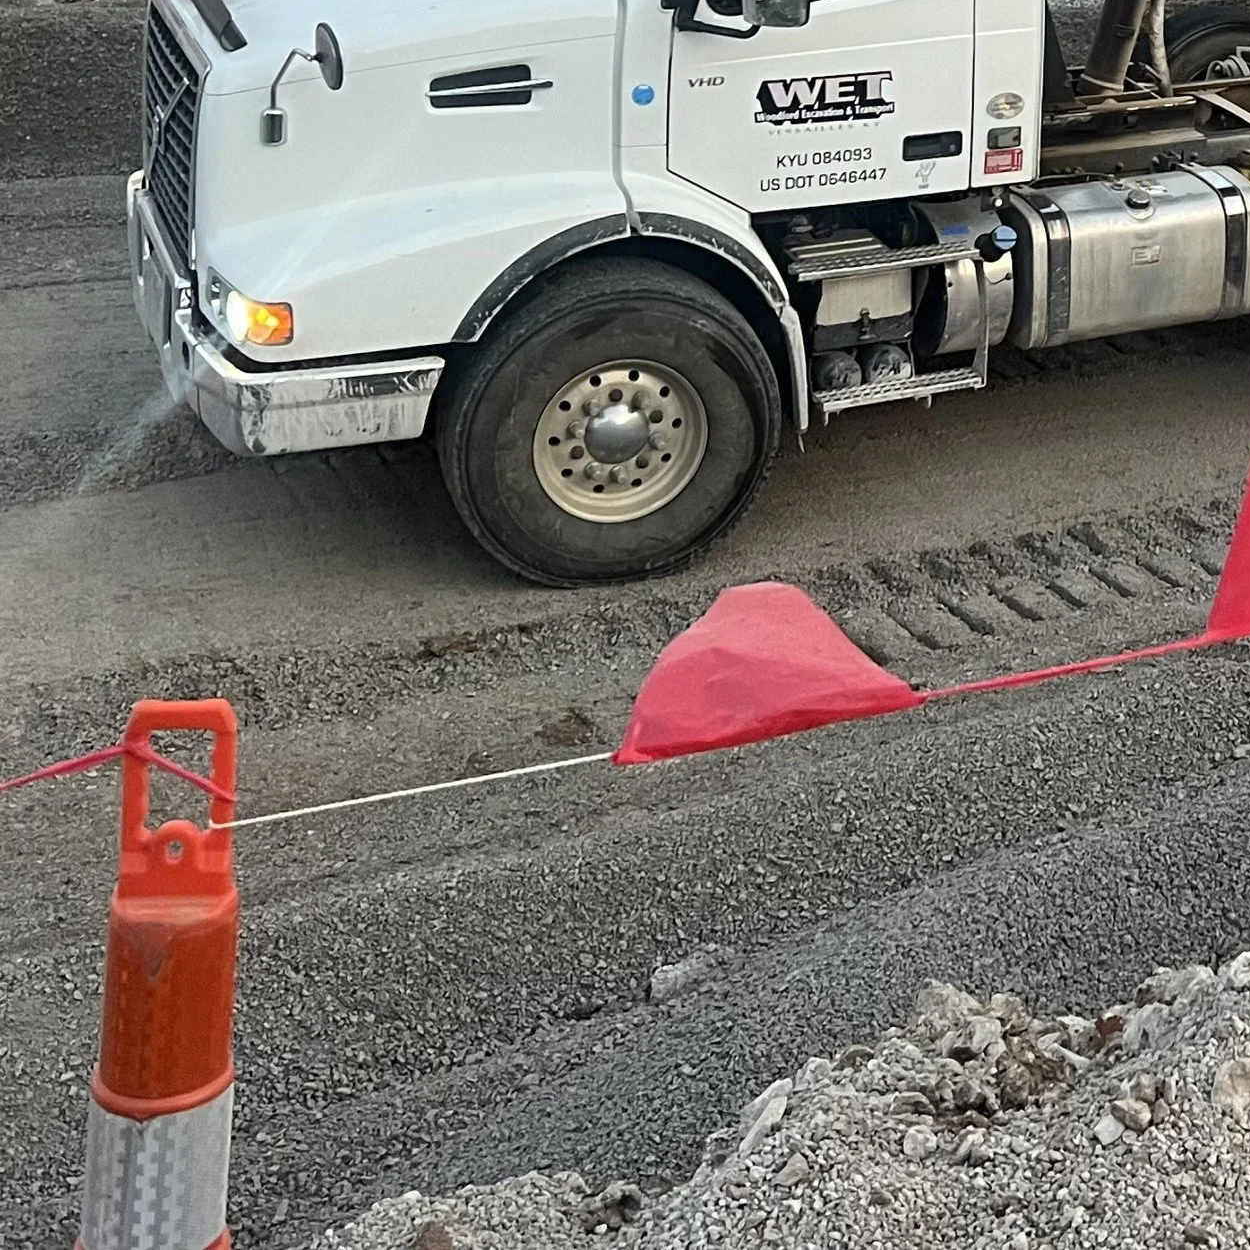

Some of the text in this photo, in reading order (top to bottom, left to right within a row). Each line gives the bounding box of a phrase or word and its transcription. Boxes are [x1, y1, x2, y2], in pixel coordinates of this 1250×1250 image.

[688, 76, 725, 87] VHD
[764, 71, 893, 108] WET
[756, 109, 800, 122] Woodford
[846, 106, 853, 116] &
[768, 123, 854, 136] VERSAILLES
[776, 147, 873, 168] KYU 084093
[760, 167, 887, 192] US DOT 0646447
